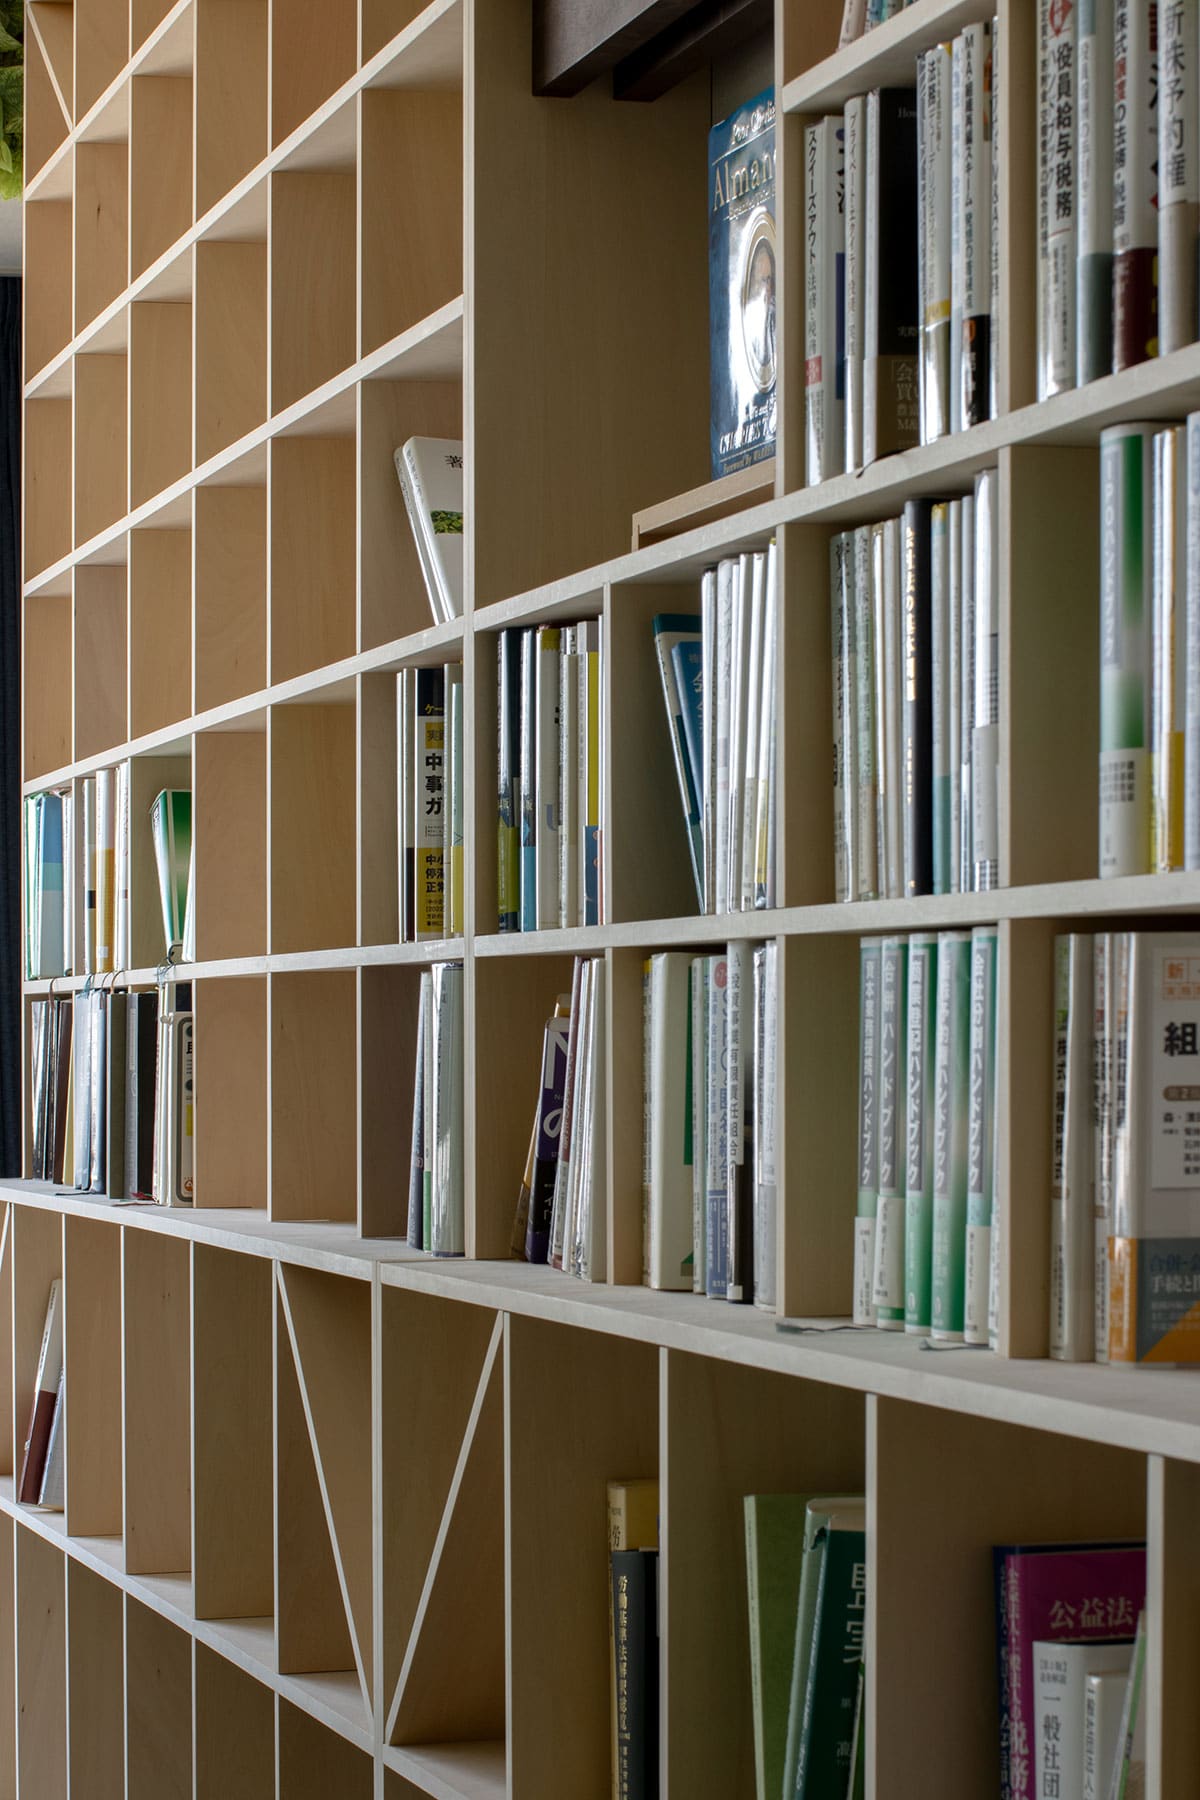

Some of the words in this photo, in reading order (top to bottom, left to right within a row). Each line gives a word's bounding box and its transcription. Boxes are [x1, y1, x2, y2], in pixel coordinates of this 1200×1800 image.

[1056, 42, 1073, 221] 役員給与税務
[970, 953, 985, 1186] 会社分割ハンドブック
[1048, 1596, 1146, 1629] 公益法
